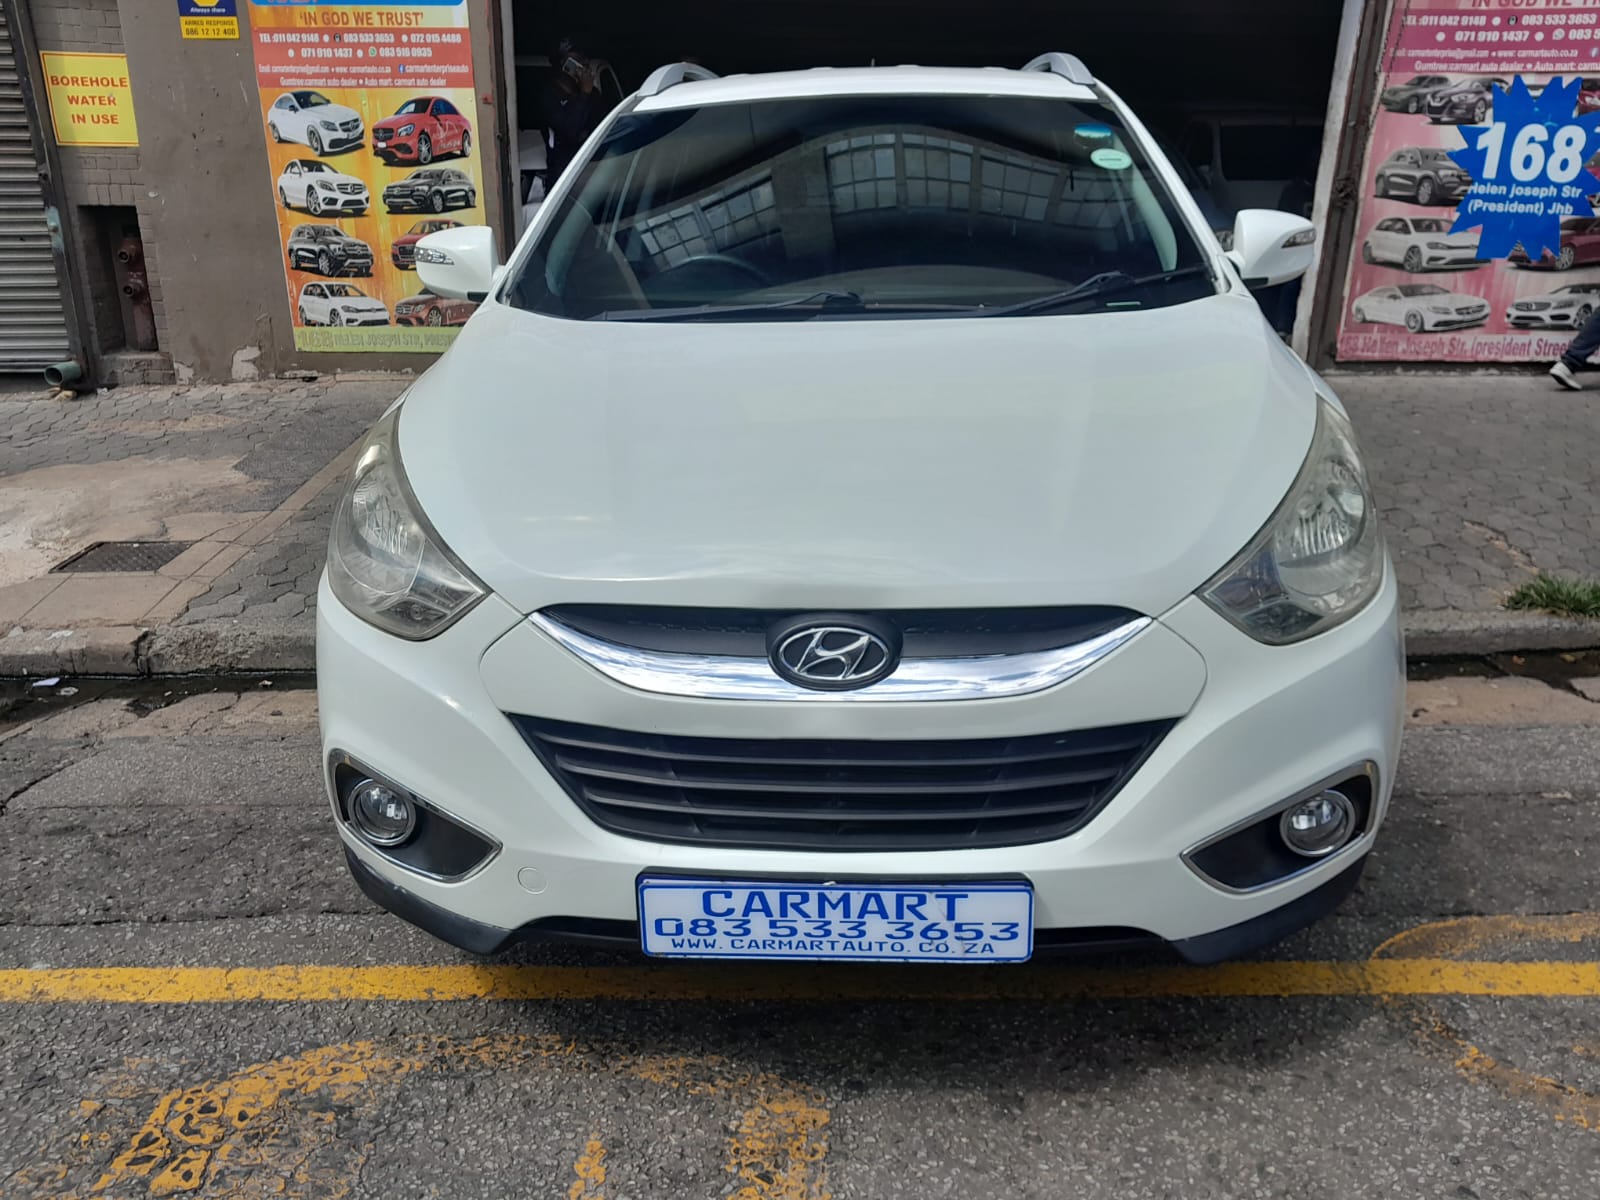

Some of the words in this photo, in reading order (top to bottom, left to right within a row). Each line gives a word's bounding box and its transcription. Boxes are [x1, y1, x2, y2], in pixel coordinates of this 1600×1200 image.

[321, 11, 350, 26] GOD
[353, 11, 374, 26] WE
[1439, 15, 1459, 26] 042
[1521, 14, 1544, 26] 083
[1544, 14, 1567, 26] 533
[1567, 13, 1598, 25] 3653
[201, 28, 209, 36] 12
[213, 28, 220, 36] 12
[1455, 31, 1476, 42] 071
[1502, 30, 1530, 42] 1437
[1568, 29, 1592, 40] 083
[301, 47, 316, 58] 071
[333, 47, 353, 58] 1437
[50, 75, 129, 88] BOREHOLE
[67, 95, 118, 107] WATER
[71, 113, 87, 125] IN
[91, 114, 120, 125] USE
[1476, 121, 1587, 184] 168
[1468, 181, 1507, 195] Helen
[1561, 184, 1583, 198] Str
[1468, 198, 1544, 216] (President)
[1547, 202, 1574, 216] Jhb
[702, 890, 969, 921] CARMART
[654, 917, 752, 938] 083
[768, 919, 867, 939] 533
[884, 921, 1020, 942] 3653
